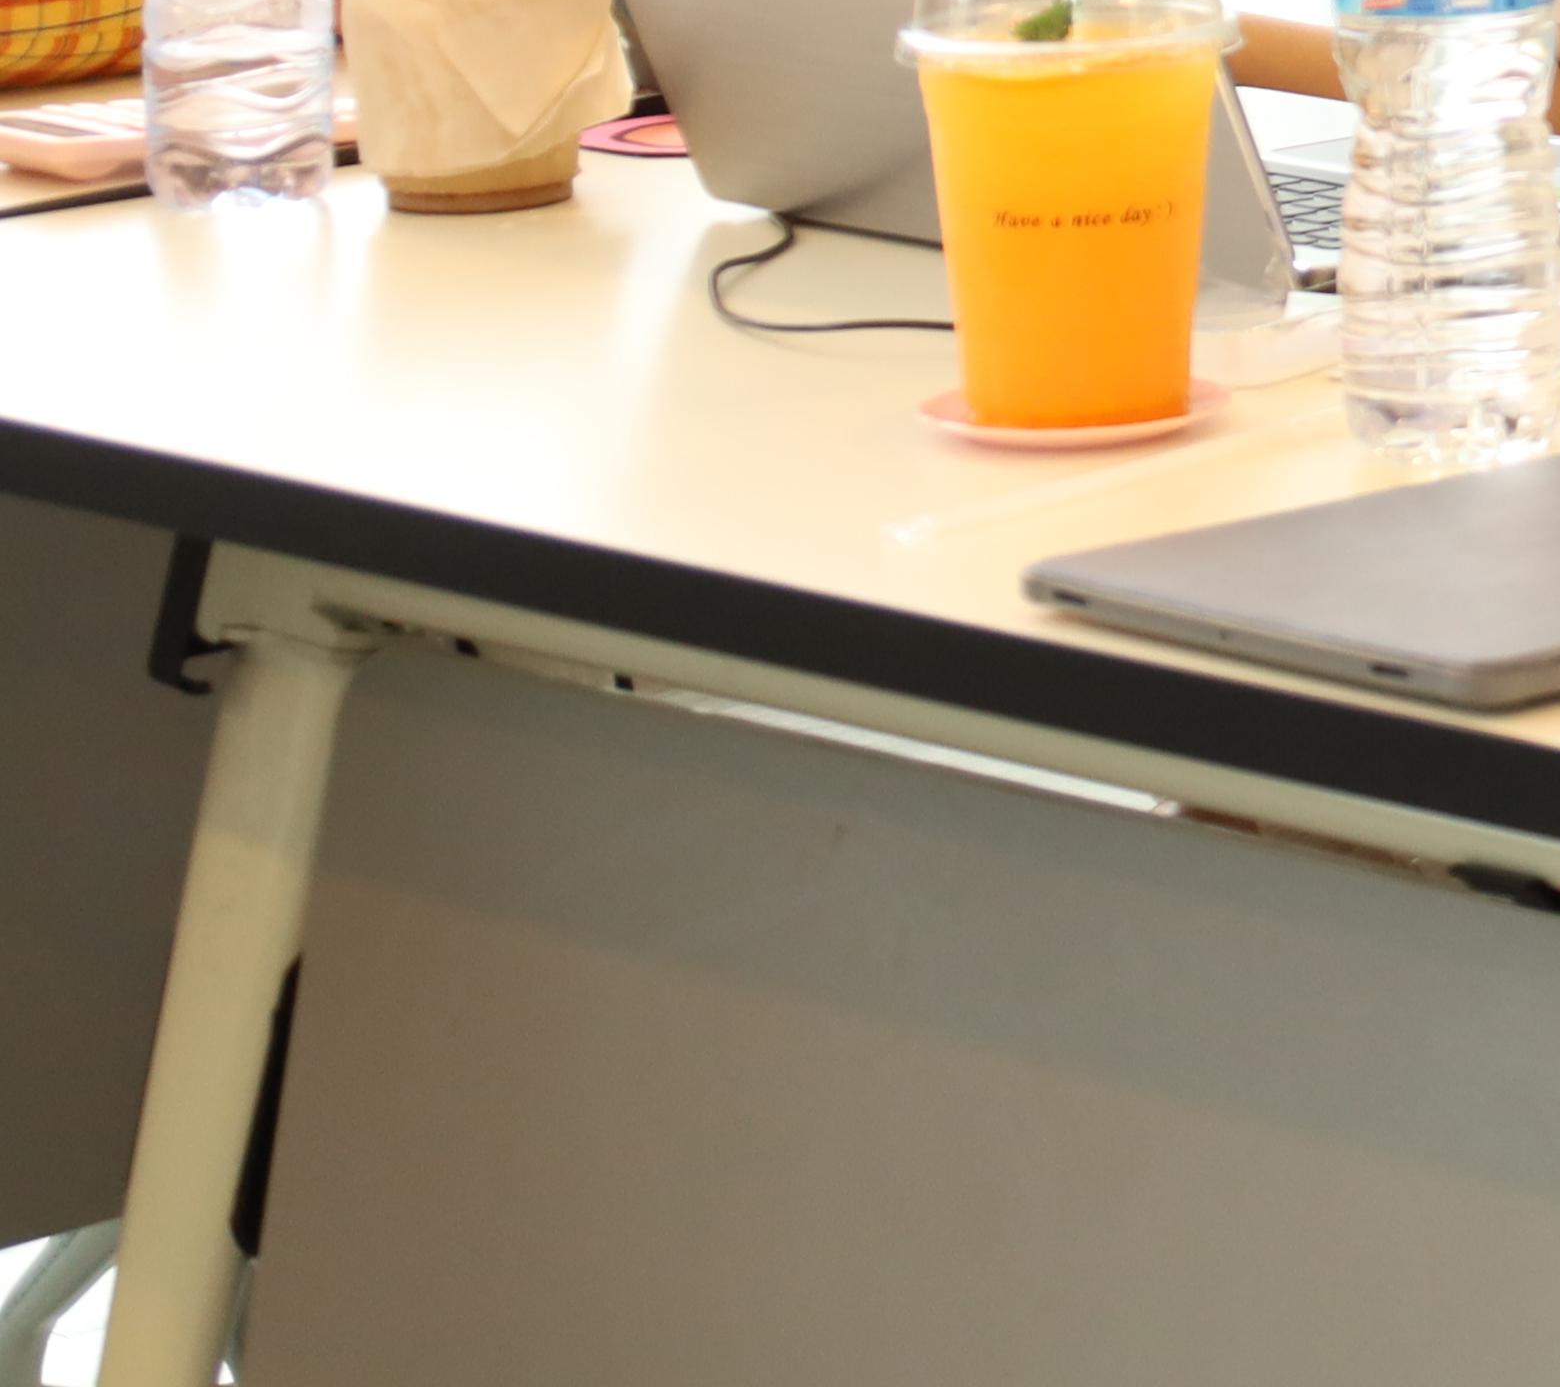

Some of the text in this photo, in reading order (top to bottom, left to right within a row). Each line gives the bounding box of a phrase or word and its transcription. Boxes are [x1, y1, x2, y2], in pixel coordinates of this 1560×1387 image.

[994, 209, 1041, 228] Have
[1051, 216, 1062, 228] a
[1072, 211, 1112, 227] nice
